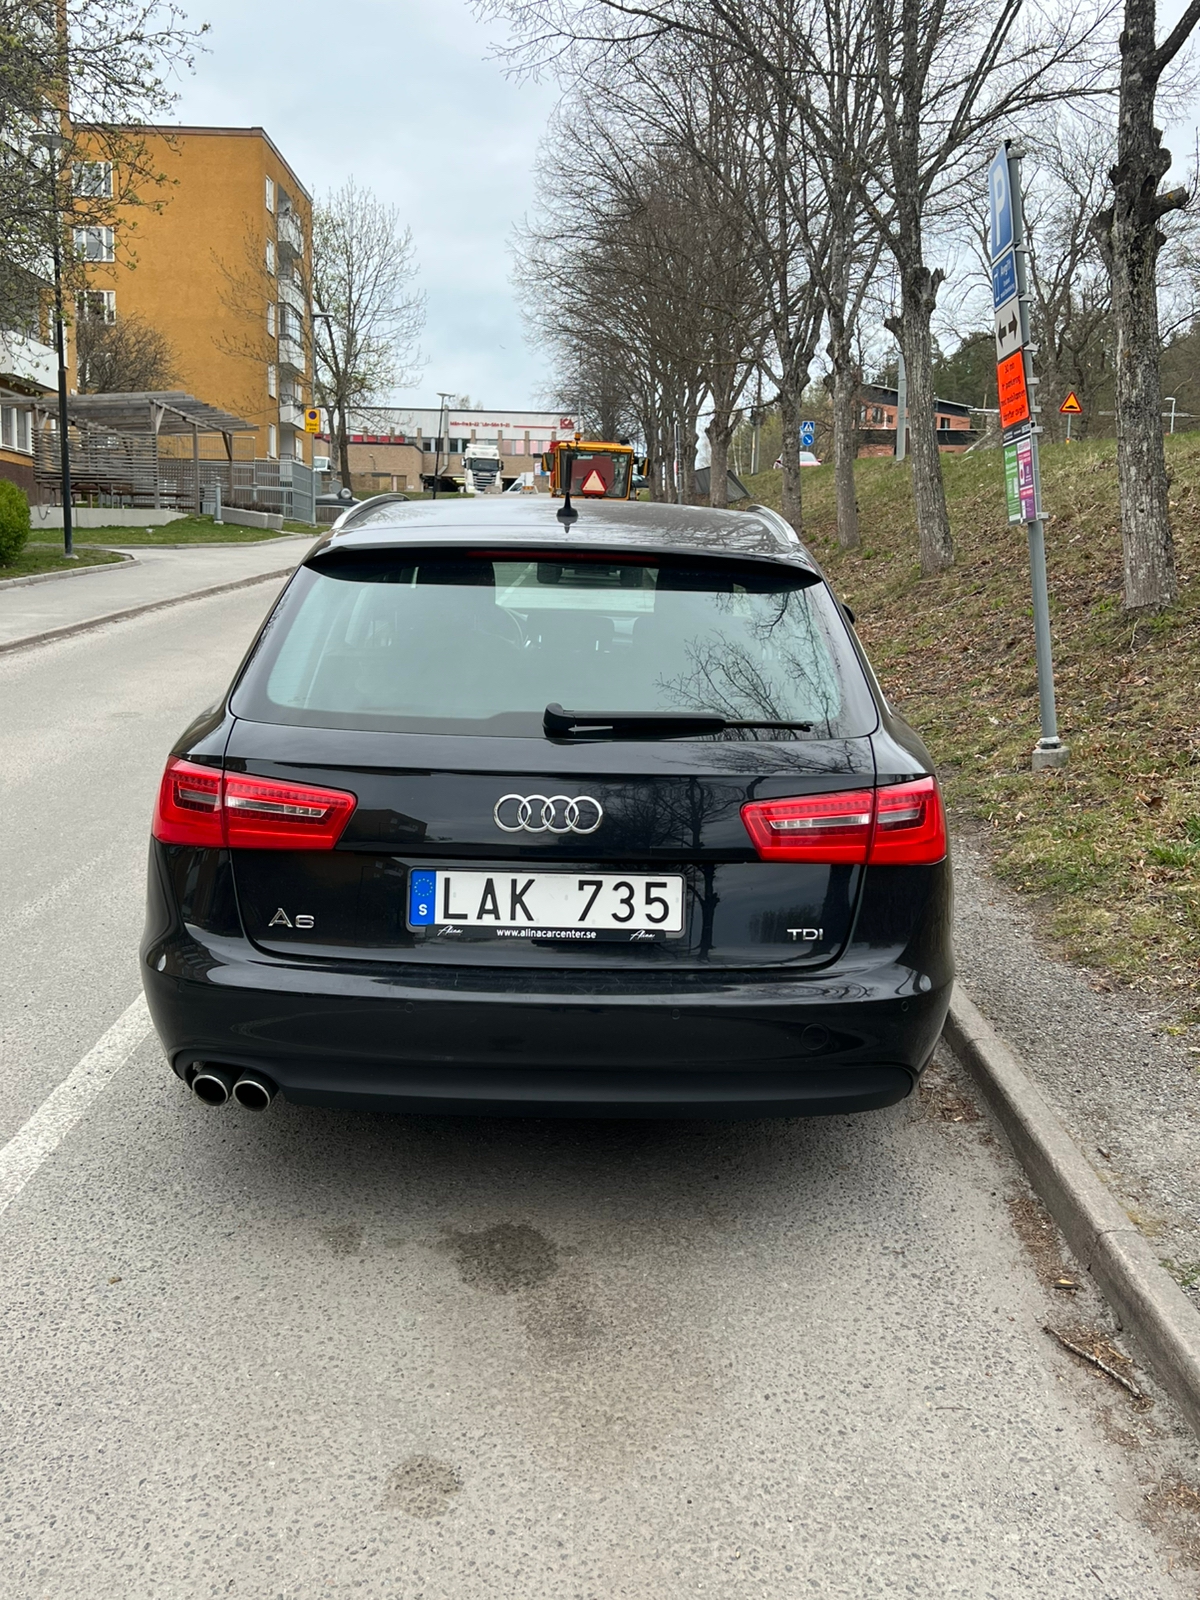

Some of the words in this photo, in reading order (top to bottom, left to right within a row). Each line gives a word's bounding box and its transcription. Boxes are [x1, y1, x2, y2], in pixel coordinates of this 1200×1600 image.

[993, 164, 1006, 247] P
[443, 876, 536, 922] LAK
[577, 879, 670, 924] 735
[268, 907, 315, 929] A6
[418, 903, 428, 916] S
[496, 927, 597, 940] www.alinacarcenter.se
[786, 928, 824, 941] TDI
